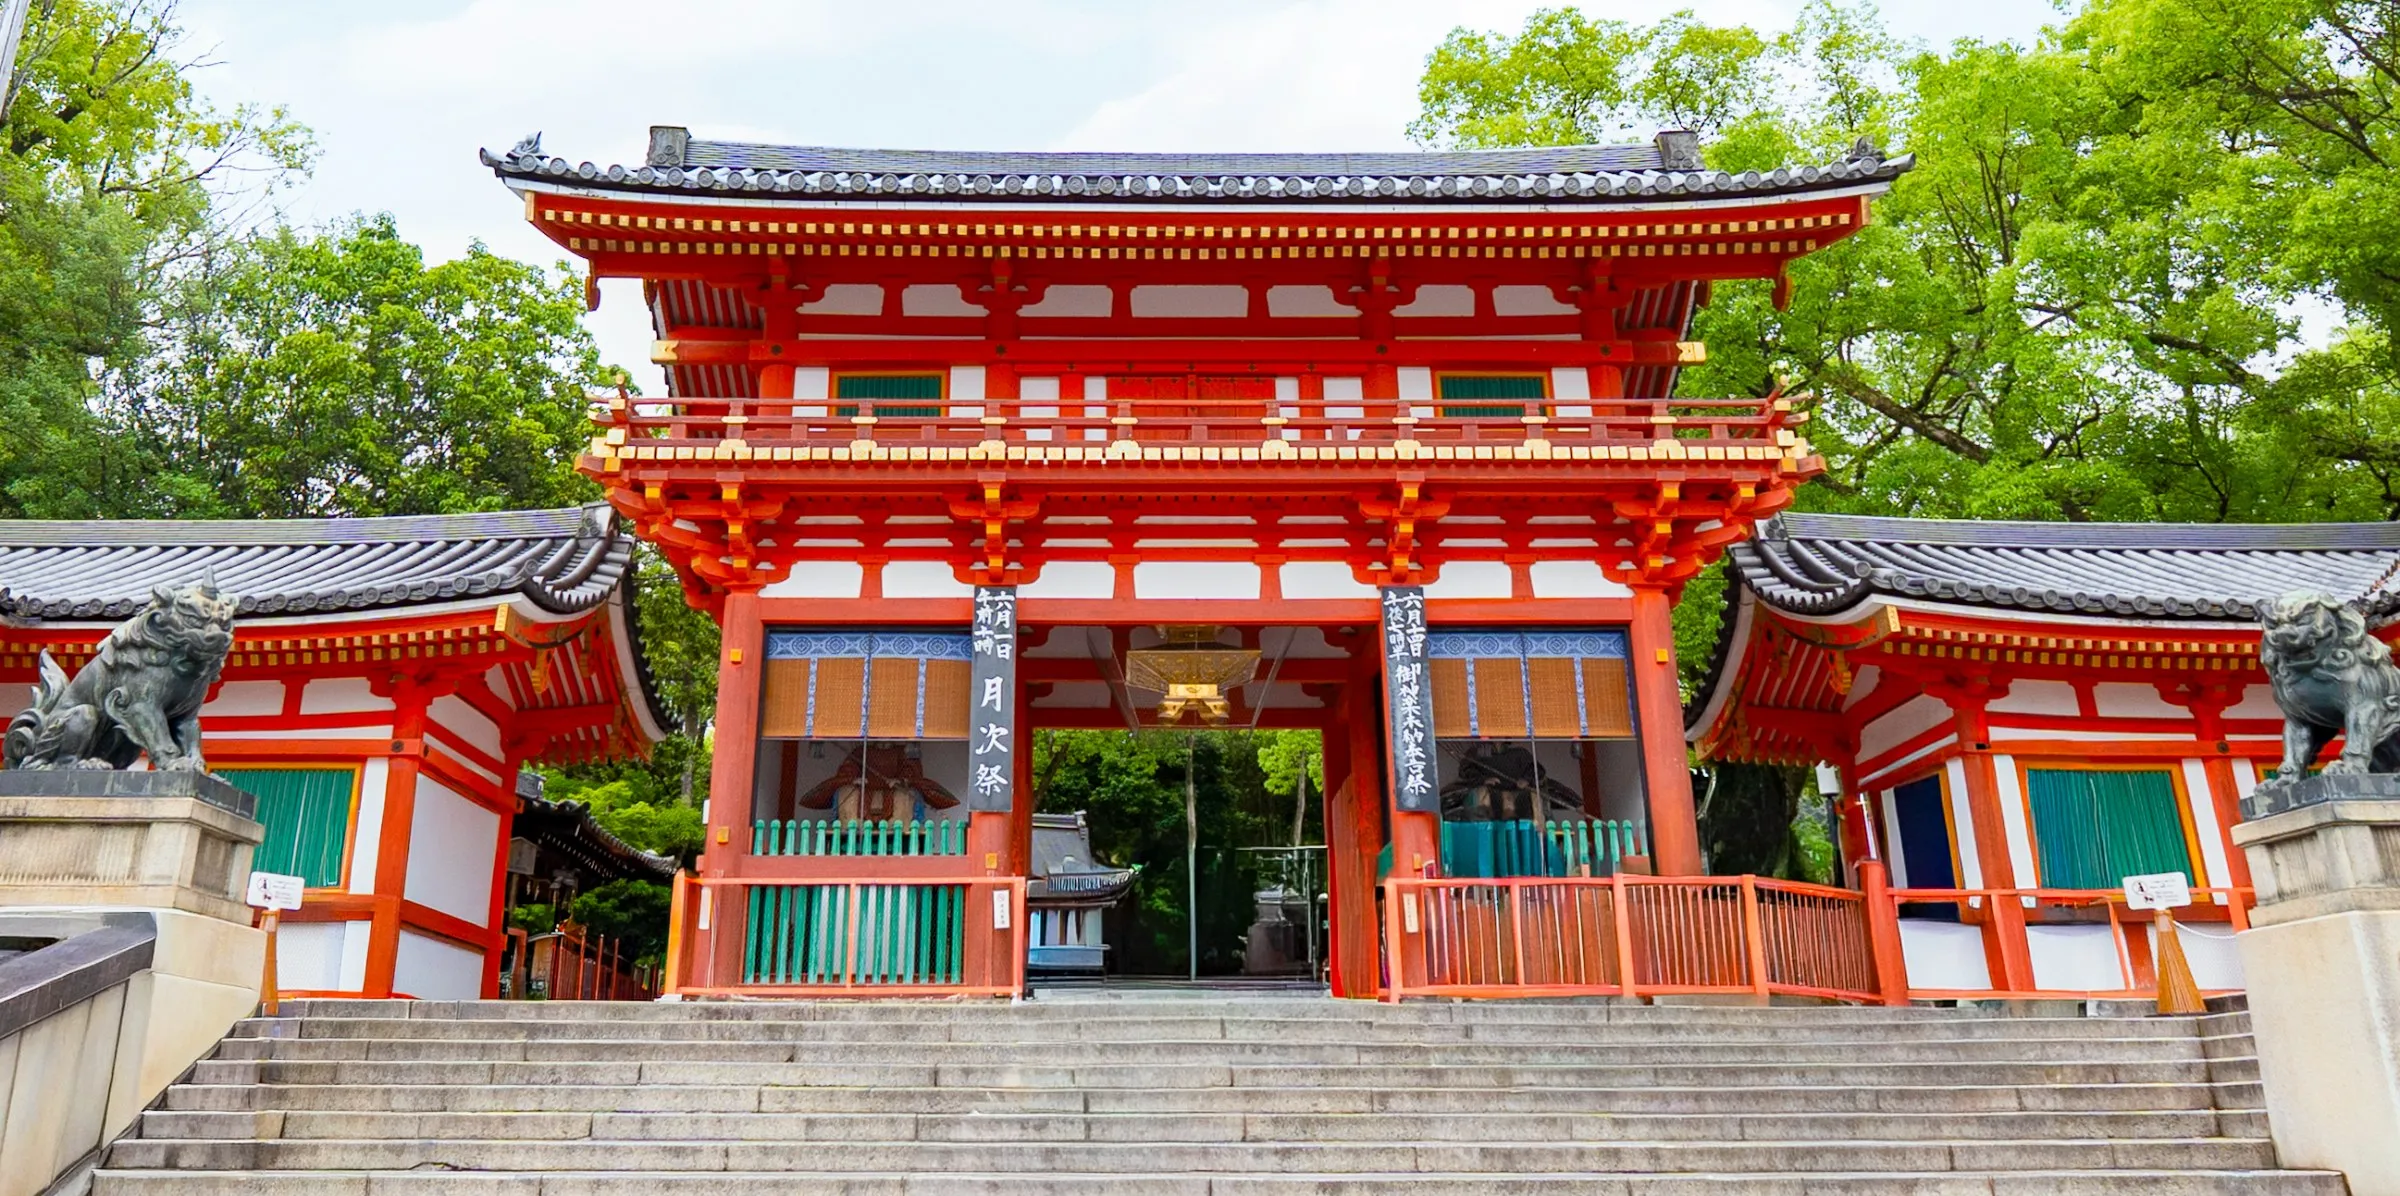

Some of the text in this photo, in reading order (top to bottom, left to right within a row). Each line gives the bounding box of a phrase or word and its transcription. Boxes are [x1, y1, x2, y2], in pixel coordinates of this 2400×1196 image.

[974, 587, 995, 656] 午前十時
[994, 590, 1015, 660] 六月一日
[975, 675, 1009, 797] 月次祭
